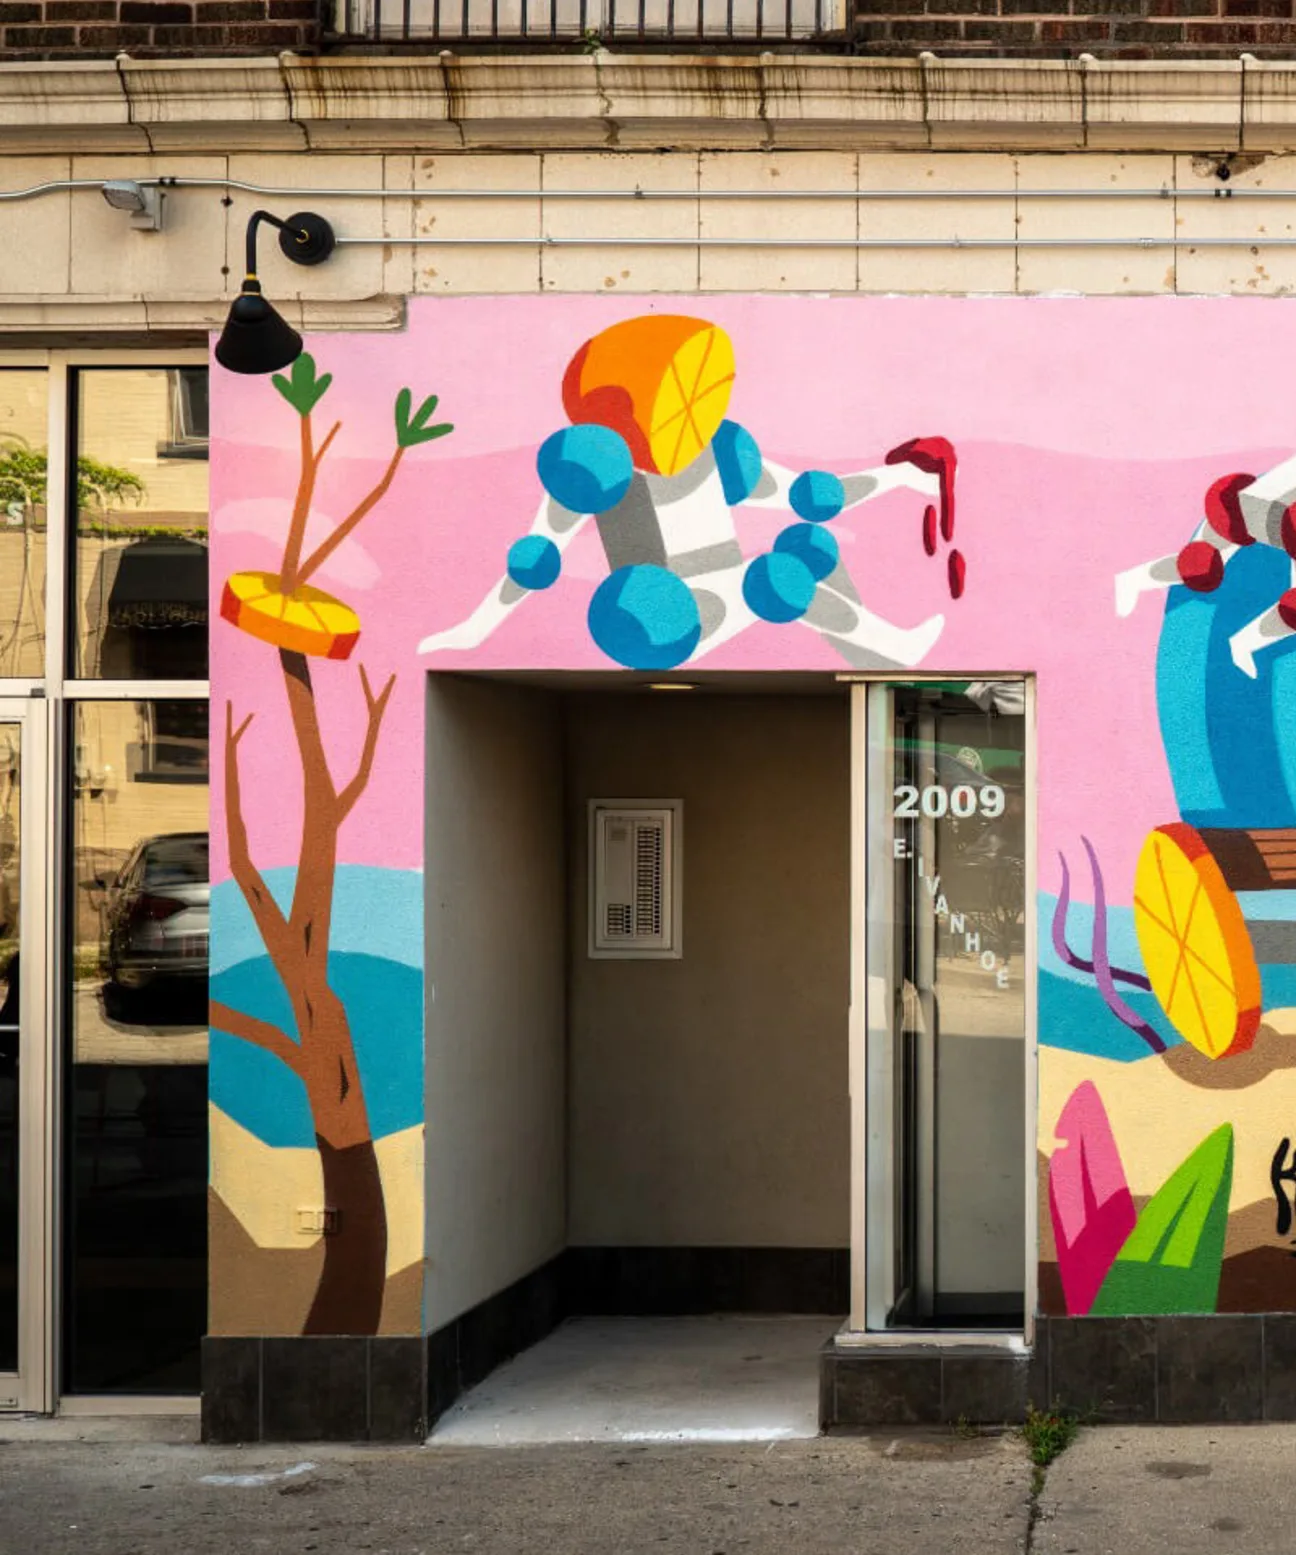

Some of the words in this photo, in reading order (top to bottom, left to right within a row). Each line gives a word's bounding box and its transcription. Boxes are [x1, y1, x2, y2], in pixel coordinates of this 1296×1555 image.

[893, 785, 1005, 817] 2009
[893, 838, 912, 859] E.
[918, 857, 1009, 988] IVANHOE
